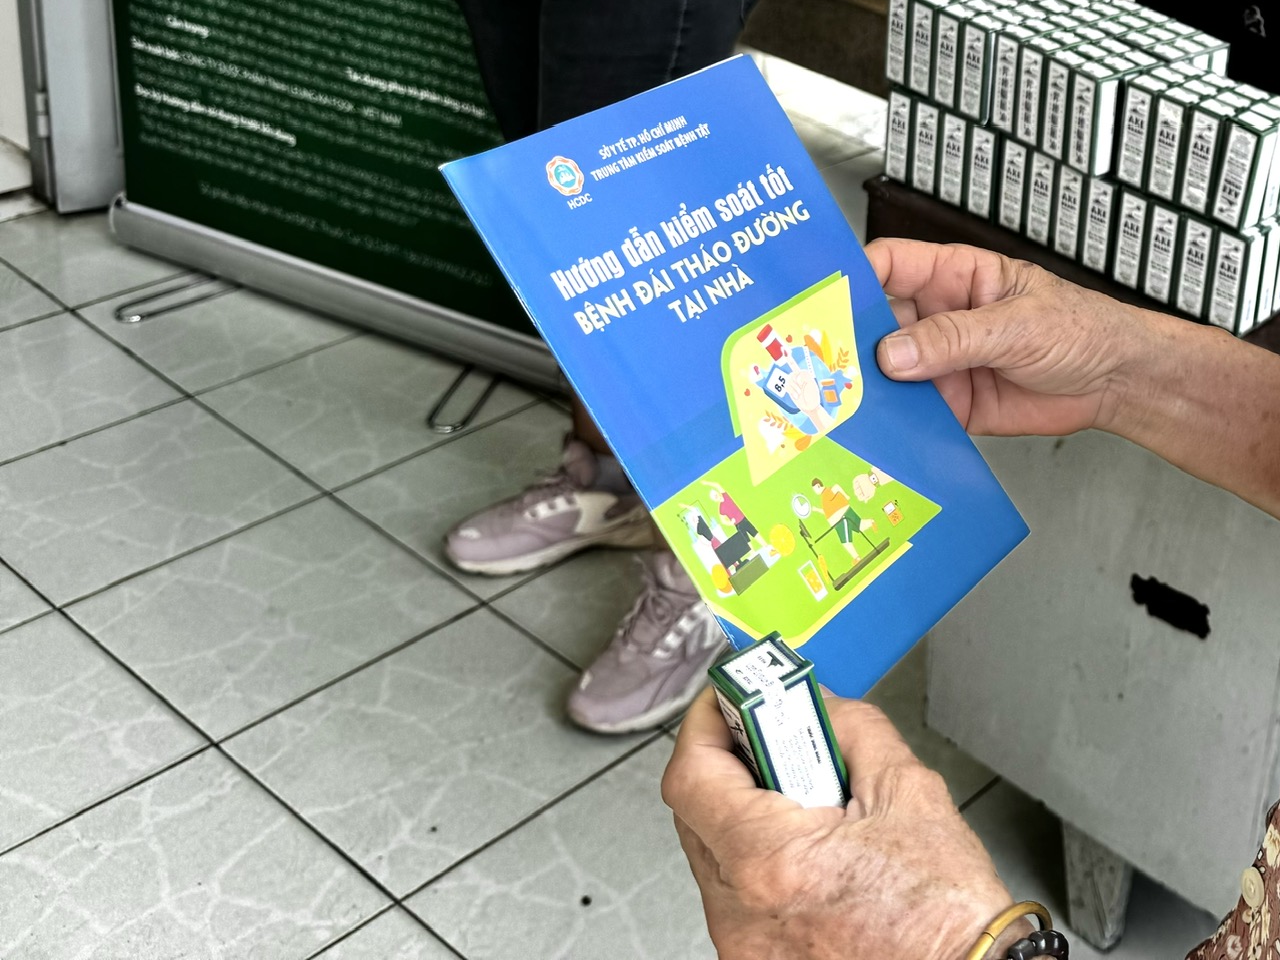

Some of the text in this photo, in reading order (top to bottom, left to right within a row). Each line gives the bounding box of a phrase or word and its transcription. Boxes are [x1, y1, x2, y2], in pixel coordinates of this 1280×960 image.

[590, 123, 711, 181] TRUNG TÂM KIỂM SOÁT BỆNH TẬT
[598, 115, 688, 160] SỞ Y TẾ TP. HỒ CHÍ MINH
[567, 192, 593, 210] HCDC
[550, 163, 795, 301] Hướng dẫn kiểm soát tốt
[573, 200, 811, 335] BỆNH ĐÁI THÁO ĐƯỜNG
[668, 264, 755, 323] TẠI NHÀ
